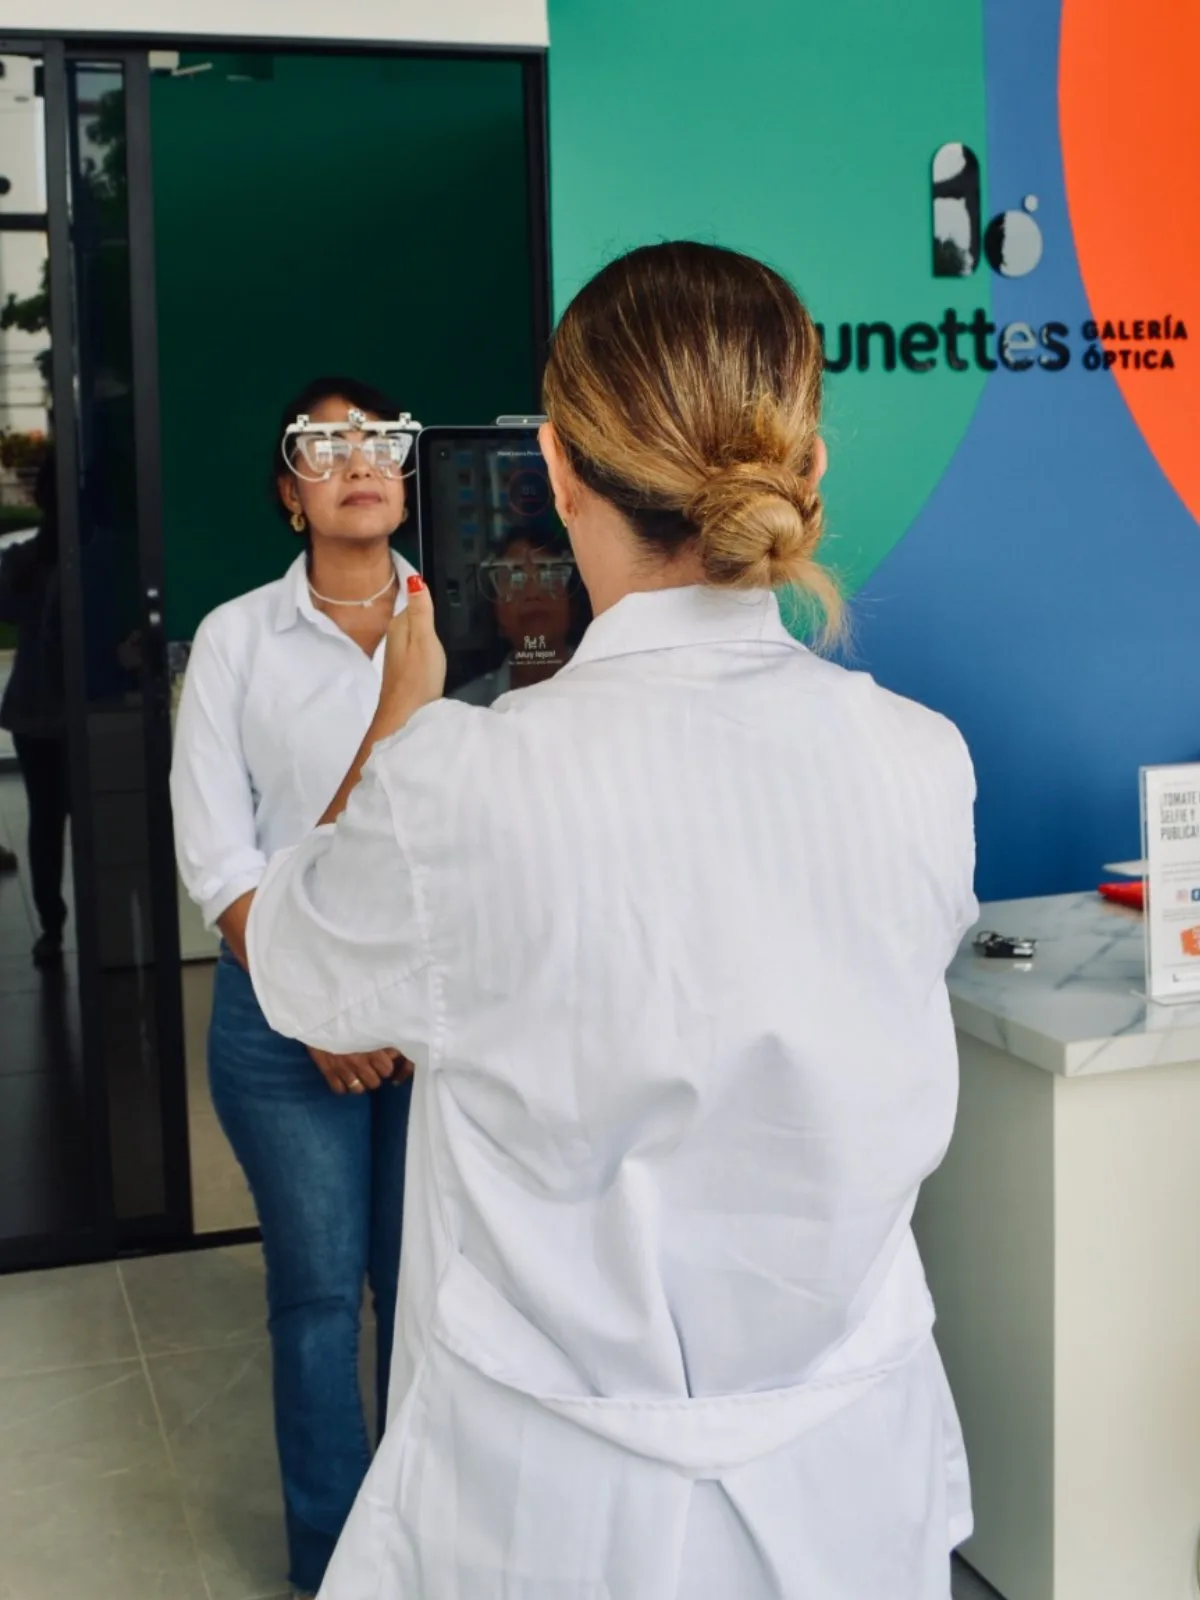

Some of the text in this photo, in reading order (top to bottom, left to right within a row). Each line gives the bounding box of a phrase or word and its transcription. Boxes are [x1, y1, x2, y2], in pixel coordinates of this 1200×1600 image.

[1081, 314, 1188, 341] GALERÍA
[1081, 347, 1175, 371] ÓPTICA
[1160, 808, 1187, 823] SELFIE
